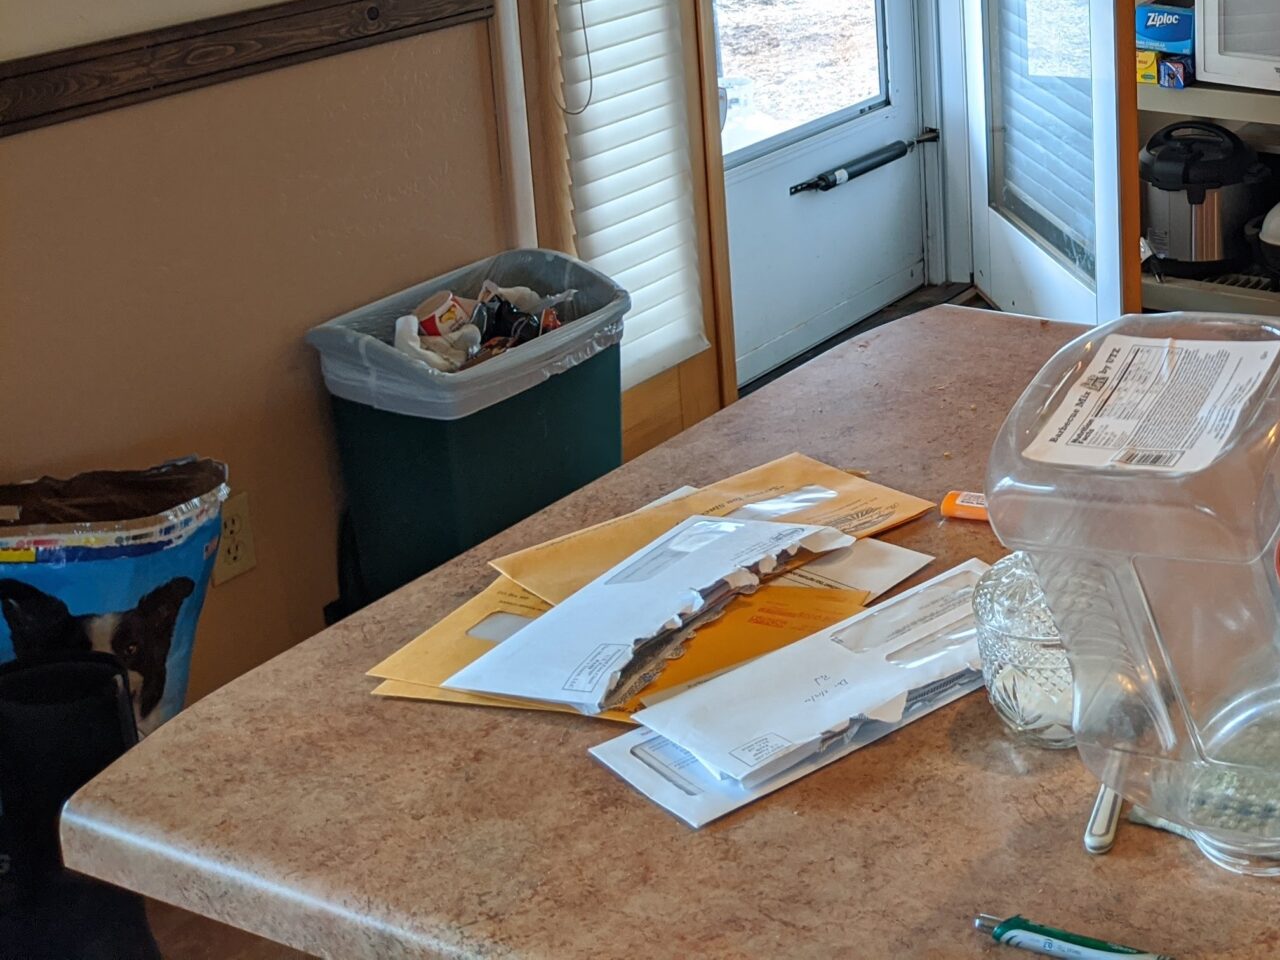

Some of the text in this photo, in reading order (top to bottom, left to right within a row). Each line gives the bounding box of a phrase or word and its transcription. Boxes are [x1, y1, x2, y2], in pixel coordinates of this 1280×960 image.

[1146, 12, 1180, 27] Ziploc
[1048, 407, 1080, 444] Barbecue
[1077, 391, 1091, 411] Mix
[1105, 347, 1122, 367] UTZ
